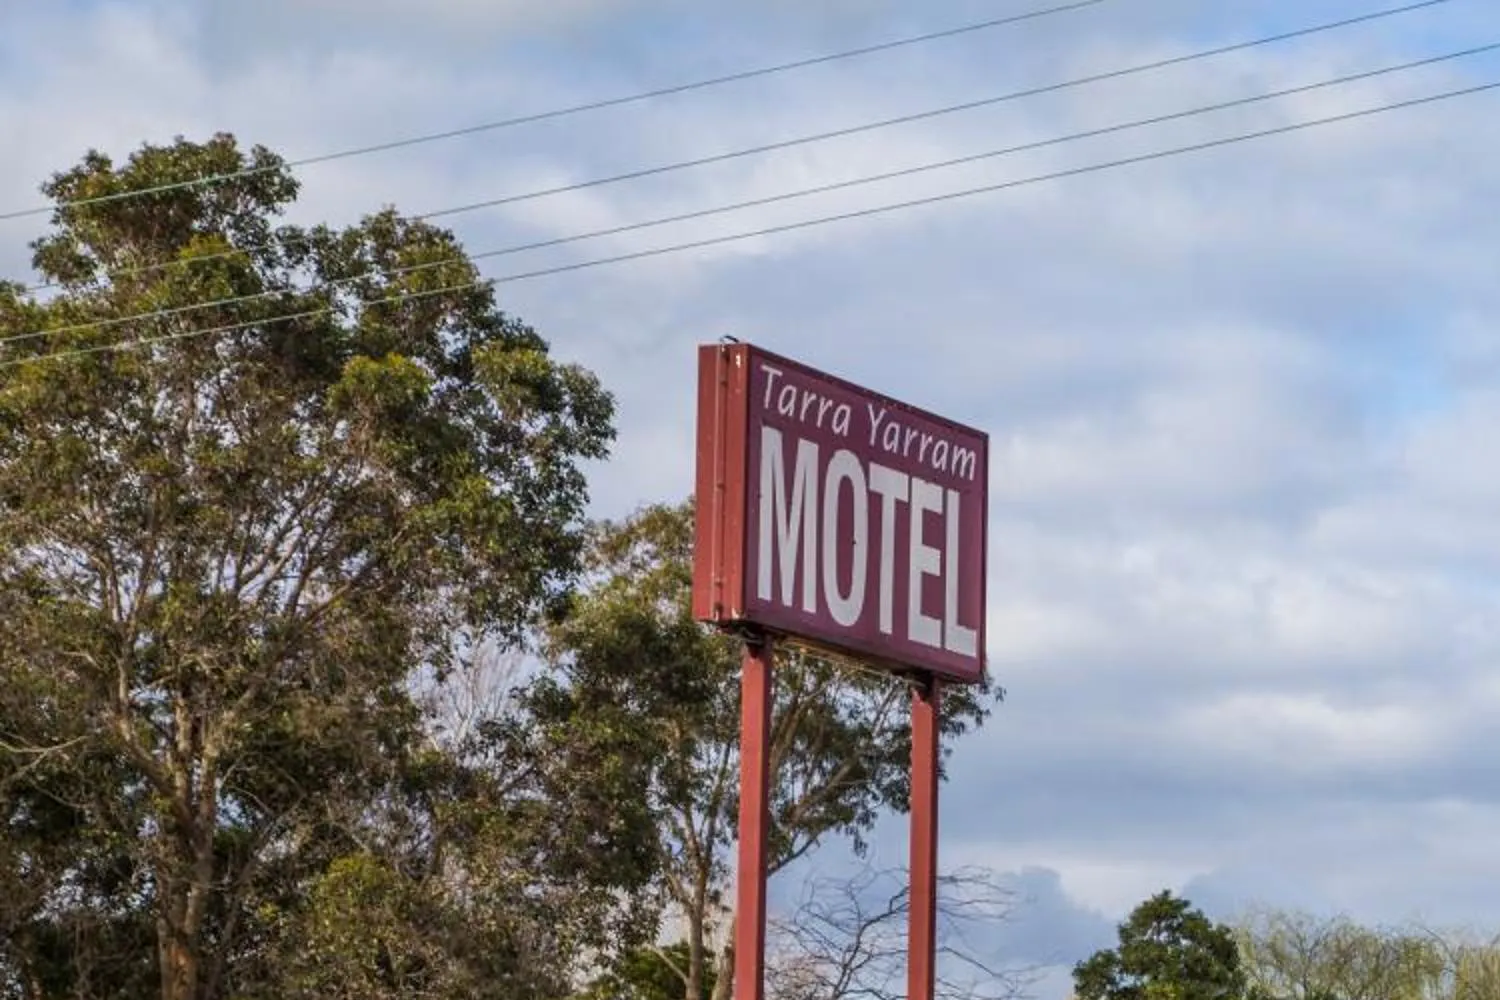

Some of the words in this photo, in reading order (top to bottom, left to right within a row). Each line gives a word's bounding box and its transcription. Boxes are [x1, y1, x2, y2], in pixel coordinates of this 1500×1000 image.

[760, 364, 851, 436] Tarra
[867, 403, 976, 481] Yarram
[757, 425, 977, 658] MOTEL
